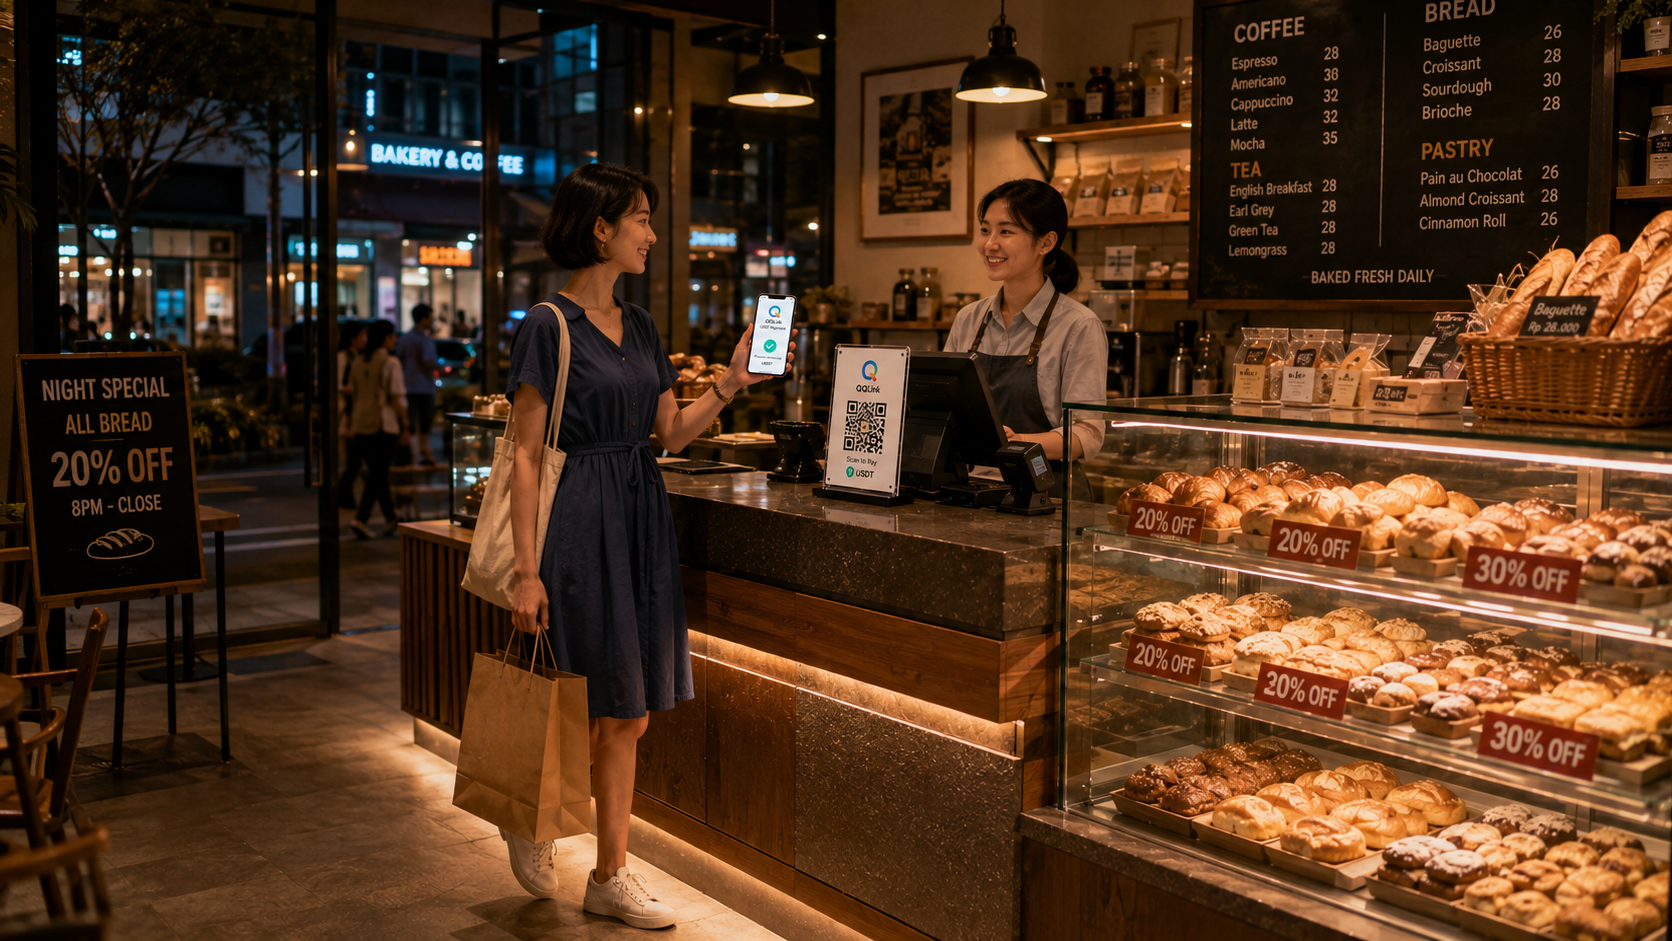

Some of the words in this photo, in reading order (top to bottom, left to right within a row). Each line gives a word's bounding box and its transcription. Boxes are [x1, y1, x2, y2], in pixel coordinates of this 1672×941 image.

[1426, 0, 1495, 22] BREAD
[1235, 16, 1304, 43] COFFEE
[1424, 34, 1480, 53] Baguette
[1544, 24, 1562, 40] 26
[1232, 56, 1277, 71] Espresso
[1324, 46, 1340, 61] 28
[1423, 57, 1481, 74] Croissant
[1544, 48, 1562, 64] 28
[1231, 75, 1286, 90] Americano
[1423, 78, 1491, 97] Sourdough
[1543, 72, 1562, 88] 30
[1231, 94, 1293, 112] Cappuccino
[1324, 89, 1339, 103] 32
[1423, 103, 1472, 119] Brioche
[1543, 96, 1561, 111] 28
[1231, 119, 1258, 131] Latte
[1323, 110, 1338, 124] 32
[1231, 137, 1265, 151] Mocha
[1323, 131, 1338, 145] 35
[1422, 139, 1493, 160] PASTRY
[371, 143, 443, 168] BAKERY
[445, 150, 459, 169] &
[1231, 161, 1261, 178] TEA
[1421, 172, 1445, 185] Pain
[1450, 174, 1463, 183] au
[1468, 167, 1522, 182] Chocolat
[1542, 165, 1559, 180] 26
[1230, 184, 1263, 199] English
[1267, 181, 1312, 195] Breakfast
[1323, 179, 1337, 193] 28
[1420, 193, 1464, 207] Almond
[1469, 191, 1524, 205] Croissant
[1542, 189, 1559, 203] 28
[1230, 204, 1248, 216] Earl
[1251, 204, 1274, 218] Grey
[1322, 200, 1337, 213] 28
[1229, 225, 1258, 236] Green
[1261, 223, 1278, 235] Tea
[1322, 221, 1336, 234] 28
[1420, 217, 1478, 229] Cinnamon
[1484, 213, 1505, 227] Roll
[1541, 212, 1558, 226] 26
[1229, 245, 1287, 258] Lemongrass
[1321, 242, 1336, 255] 28
[1312, 271, 1350, 283] BAKED
[1355, 270, 1393, 283] FRESH
[1398, 269, 1434, 282] DAILY
[1534, 303, 1587, 319] Baguette
[1528, 321, 1541, 334] Rp
[42, 379, 96, 401] NIGHT
[102, 377, 169, 399] SPECIAL
[856, 385, 880, 393] QQLink
[66, 414, 95, 434] ALL
[100, 412, 152, 433] BREAD
[51, 450, 120, 487] 20%
[128, 447, 172, 482] OFF
[856, 470, 874, 478] USDT
[72, 499, 102, 516] 8PM
[118, 494, 161, 513] CLOSE
[1135, 507, 1168, 532] 20%
[1172, 516, 1196, 535] OFF
[1277, 528, 1317, 555] 20%
[1321, 538, 1352, 560] OFF
[1475, 554, 1527, 587] 30%
[1533, 566, 1569, 592] OFF
[1134, 643, 1168, 670] 20%
[1172, 655, 1196, 675] OFF
[1264, 671, 1305, 702] 20%
[1309, 685, 1338, 708] OFF
[1490, 721, 1543, 758] 30%
[1548, 738, 1586, 767] OFF
